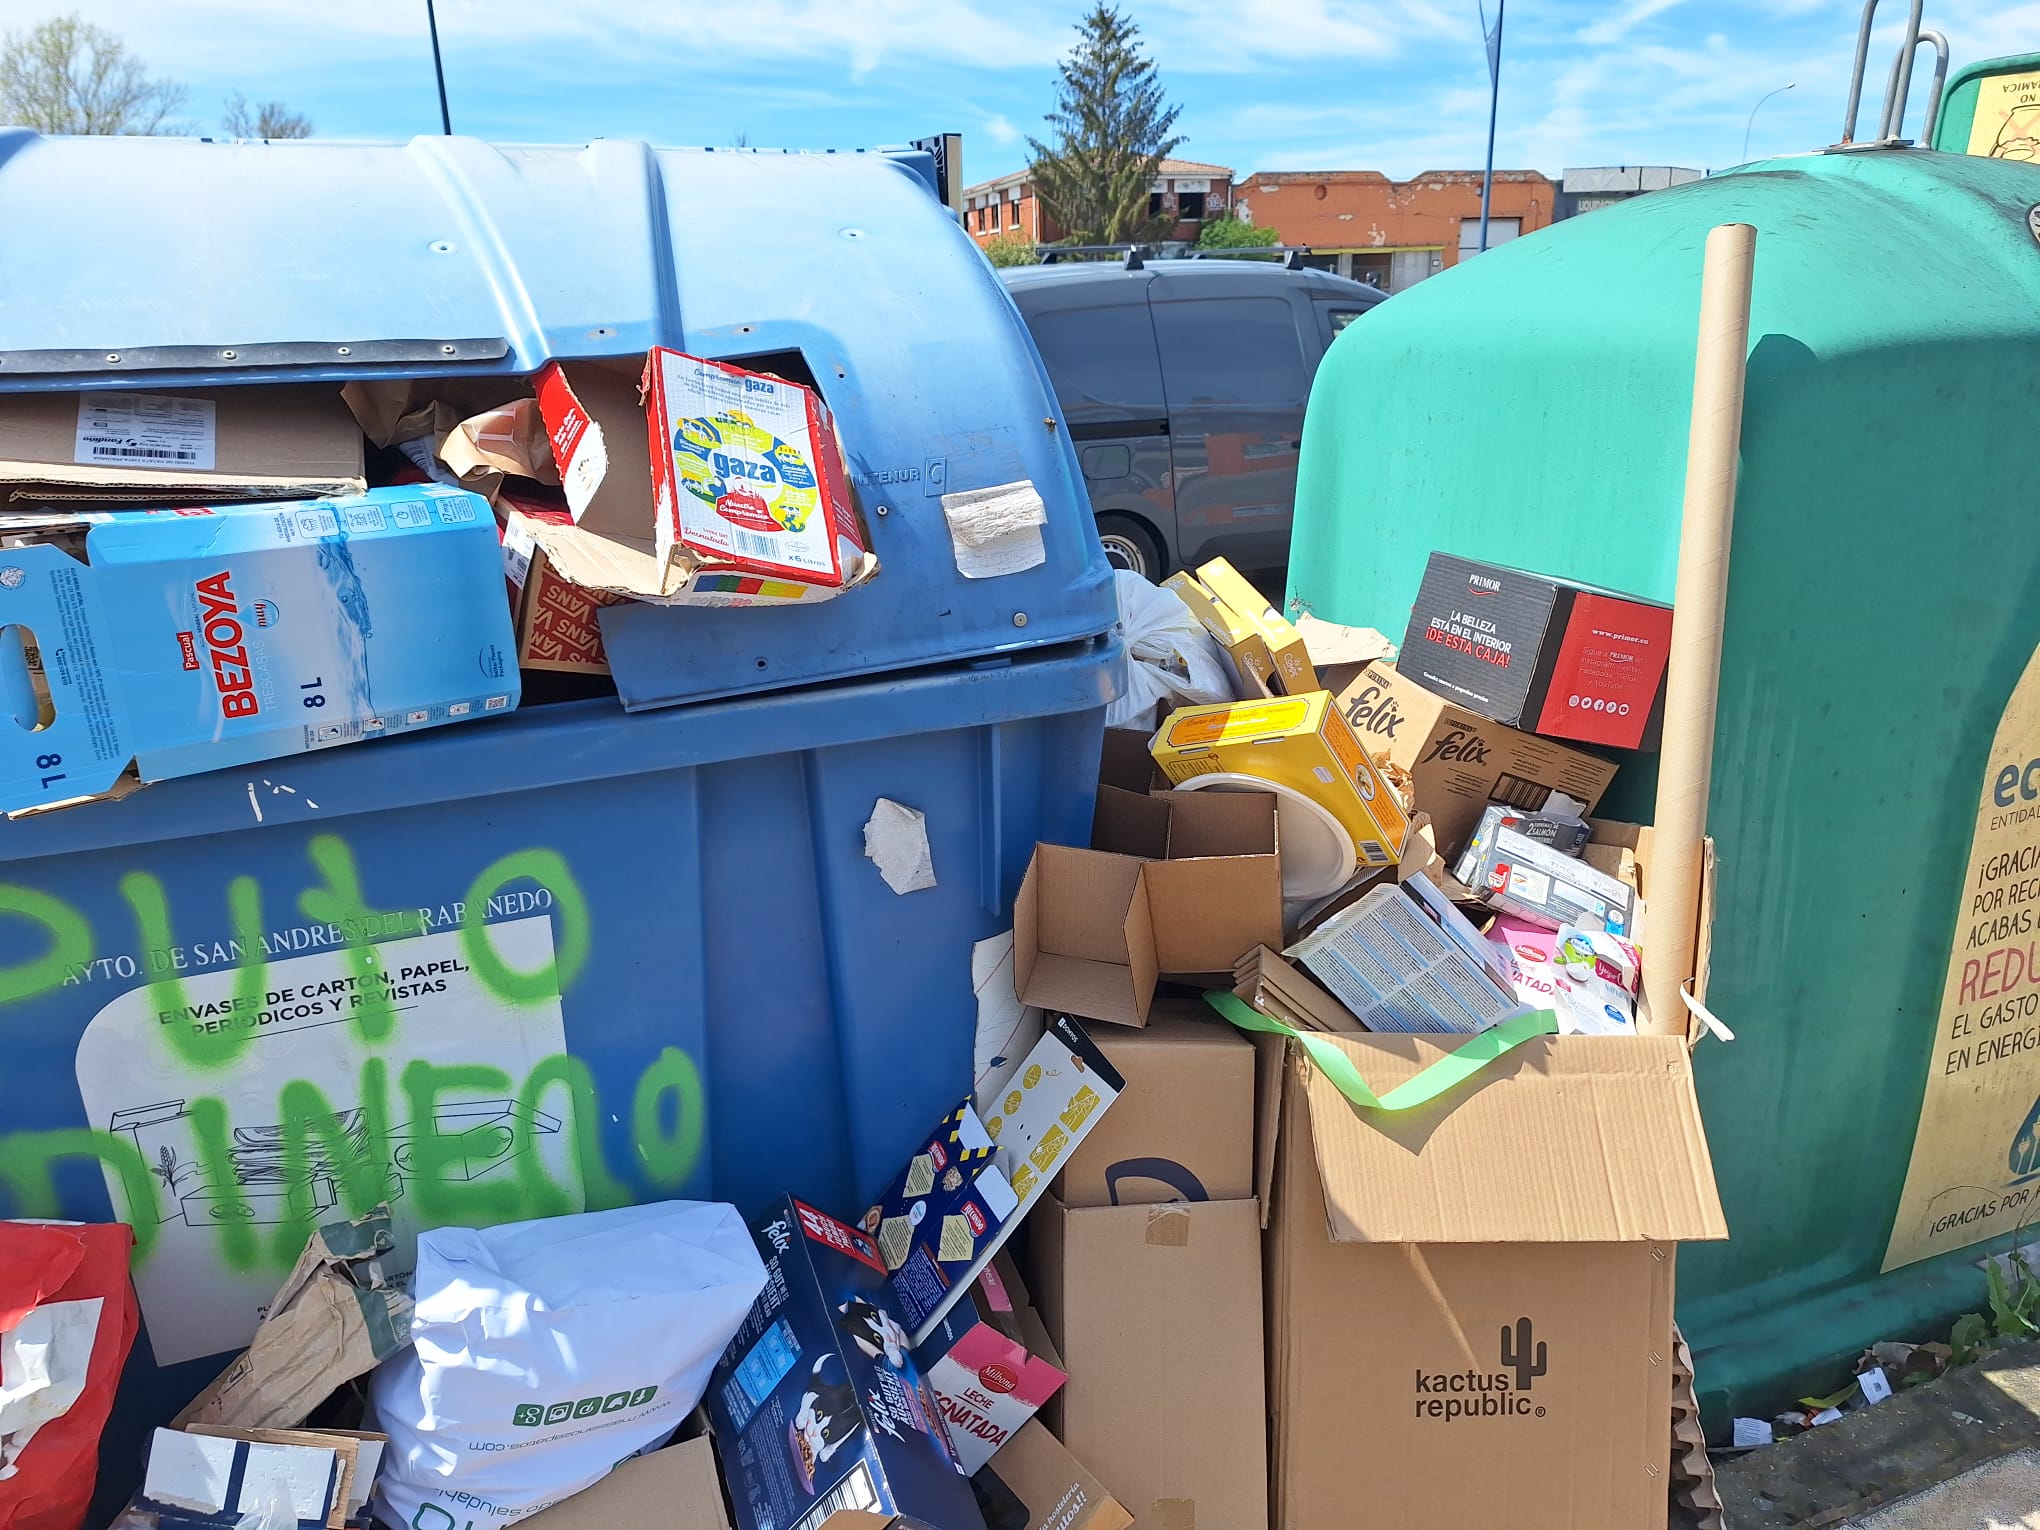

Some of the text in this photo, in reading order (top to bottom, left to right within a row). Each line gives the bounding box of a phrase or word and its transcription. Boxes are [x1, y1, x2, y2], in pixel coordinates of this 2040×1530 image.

[2020, 94, 2036, 103] NO
[744, 379, 774, 394] gaza
[713, 450, 777, 484] gaza
[1469, 574, 1501, 592] PRIMOR
[254, 603, 268, 627] muy
[547, 585, 590, 624] VANS
[557, 619, 599, 657] VANS
[1430, 617, 1512, 654] ESTÁ EN EL INTERIOR
[1450, 610, 1496, 634] LA BELLEZA
[178, 633, 196, 669] Pascual
[196, 570, 259, 718] BEZOYA
[1425, 626, 1511, 668] ¡DE ESTA CAJA!
[1609, 651, 1634, 661] PRIMOR
[252, 639, 277, 712] TRESCASAS
[300, 676, 326, 709] 8 L
[1345, 686, 1405, 738] felix
[1421, 731, 1491, 764] felix
[36, 753, 67, 790] 8 L
[1972, 878, 2040, 917] POR REC
[1966, 909, 2031, 950] ACABAS
[62, 953, 144, 987] AYTO.
[151, 946, 188, 973] DE
[193, 938, 250, 967] SAN
[254, 922, 356, 957] ANDRES
[365, 910, 418, 937] DEL
[157, 996, 260, 1026] ENVASES
[265, 988, 295, 1008] DE
[400, 958, 470, 984] PAPEL,
[327, 997, 344, 1012] Y
[348, 977, 447, 1010] REVISTAS
[1512, 970, 1555, 996] ATAD
[1951, 993, 2039, 1040] EL GASTO
[1945, 1046, 1971, 1075] EN
[799, 1208, 823, 1236] 44
[1929, 1188, 2030, 1238] ¡GRACIAS POR
[761, 1220, 791, 1256] felix
[769, 1255, 779, 1270] SO
[773, 1267, 785, 1287] GUT
[983, 1365, 1015, 1391] Milbona
[1415, 1369, 1509, 1394] kactus
[868, 1387, 906, 1443] felix
[888, 1404, 900, 1420] SO
[964, 1387, 995, 1409] LECHE
[1415, 1392, 1532, 1422] republic
